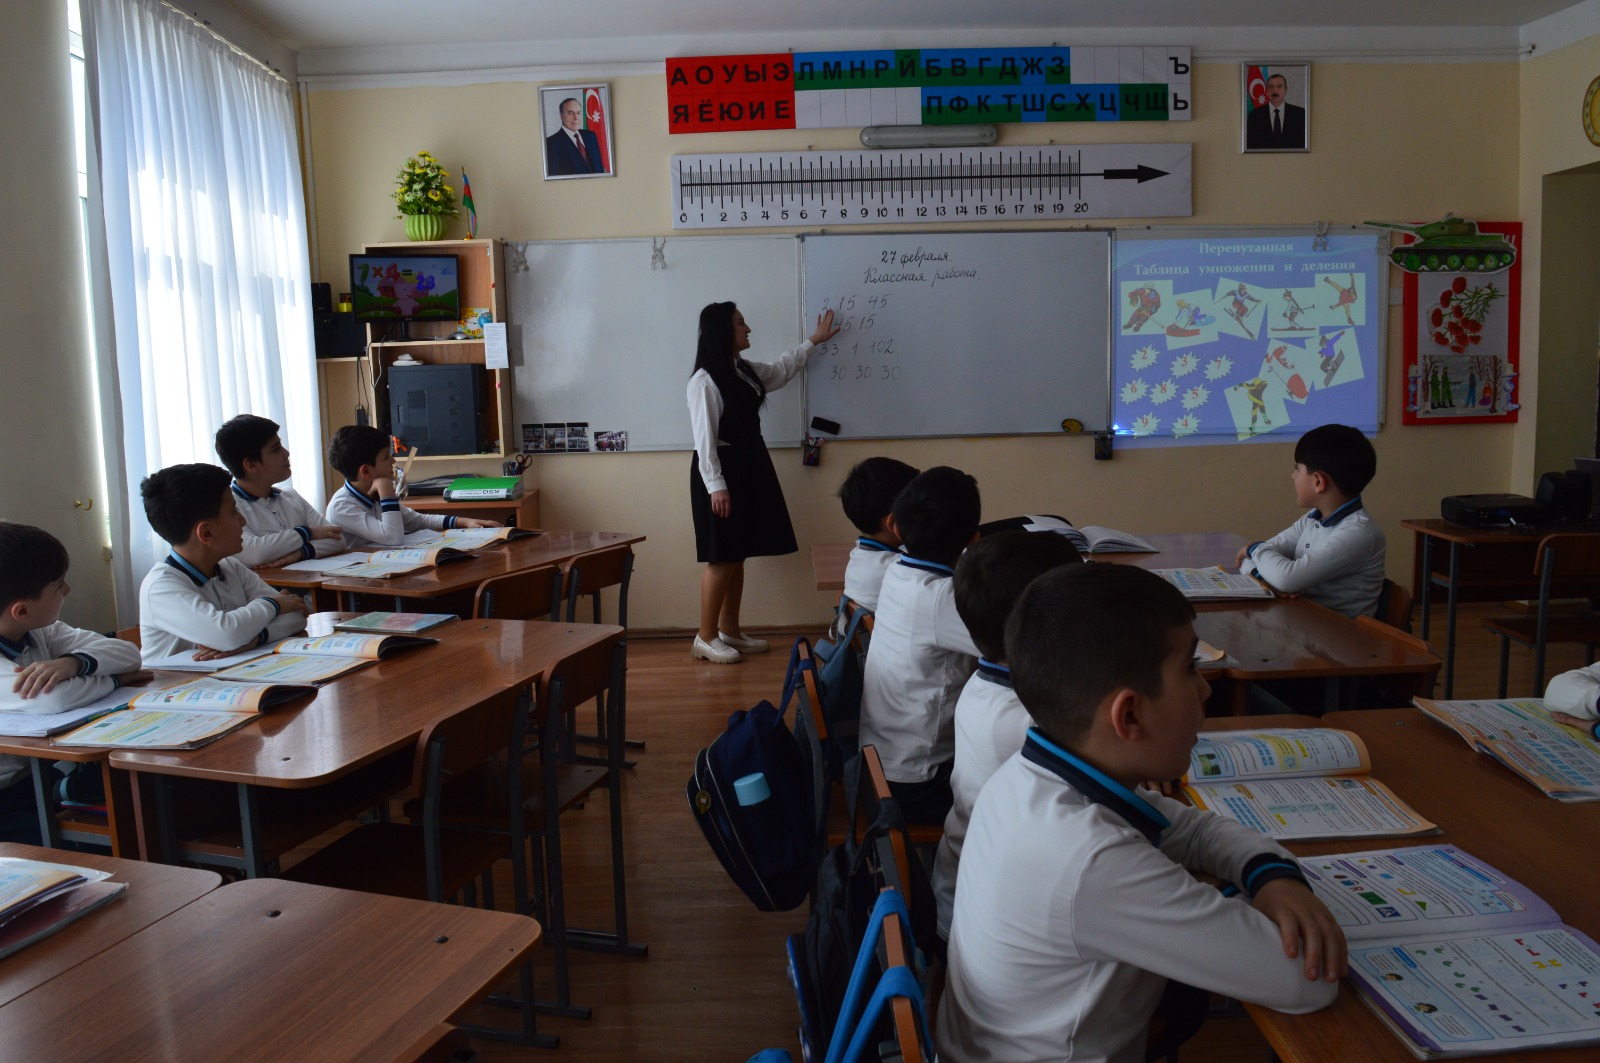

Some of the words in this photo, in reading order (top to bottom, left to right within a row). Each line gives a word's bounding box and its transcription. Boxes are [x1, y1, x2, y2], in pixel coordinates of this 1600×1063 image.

[679, 212, 688, 223] 0
[700, 212, 705, 223] 1
[719, 211, 728, 222] 2
[740, 211, 748, 222] 3
[761, 210, 771, 221] 4
[780, 210, 789, 221] 5
[799, 209, 808, 220] 6
[819, 209, 828, 219] 7
[839, 208, 848, 219] 8
[860, 208, 869, 218] 9
[876, 207, 889, 218] 10
[896, 207, 904, 217] 11
[916, 206, 929, 217] 12
[935, 206, 947, 217] 13
[955, 205, 969, 216] 14
[974, 205, 988, 216] 15
[994, 205, 1006, 215] 16
[1014, 205, 1025, 215] 17
[1033, 204, 1045, 215] 18
[1052, 204, 1065, 214] 19
[1073, 203, 1089, 214] 20
[1199, 242, 1294, 256] Перепутанная
[881, 249, 897, 265] 27
[864, 266, 928, 284] Классная
[1133, 264, 1190, 276] Таблица
[1199, 262, 1276, 275] умножения
[1284, 263, 1293, 271] и
[1301, 261, 1356, 273] деления
[838, 294, 858, 310] 15
[868, 293, 892, 309] 45
[859, 313, 878, 330] 15
[852, 341, 859, 356] 1
[870, 338, 896, 354] 102
[1141, 350, 1148, 360] 2
[1181, 356, 1188, 367] 3
[1215, 359, 1222, 370] 7
[830, 365, 847, 381] 30
[855, 364, 872, 380] 30
[881, 365, 902, 381] 30
[1130, 383, 1138, 394] 6
[1160, 383, 1167, 394] 8
[1192, 388, 1199, 399] 5
[1141, 417, 1149, 428] 9
[1181, 418, 1189, 428] 4
